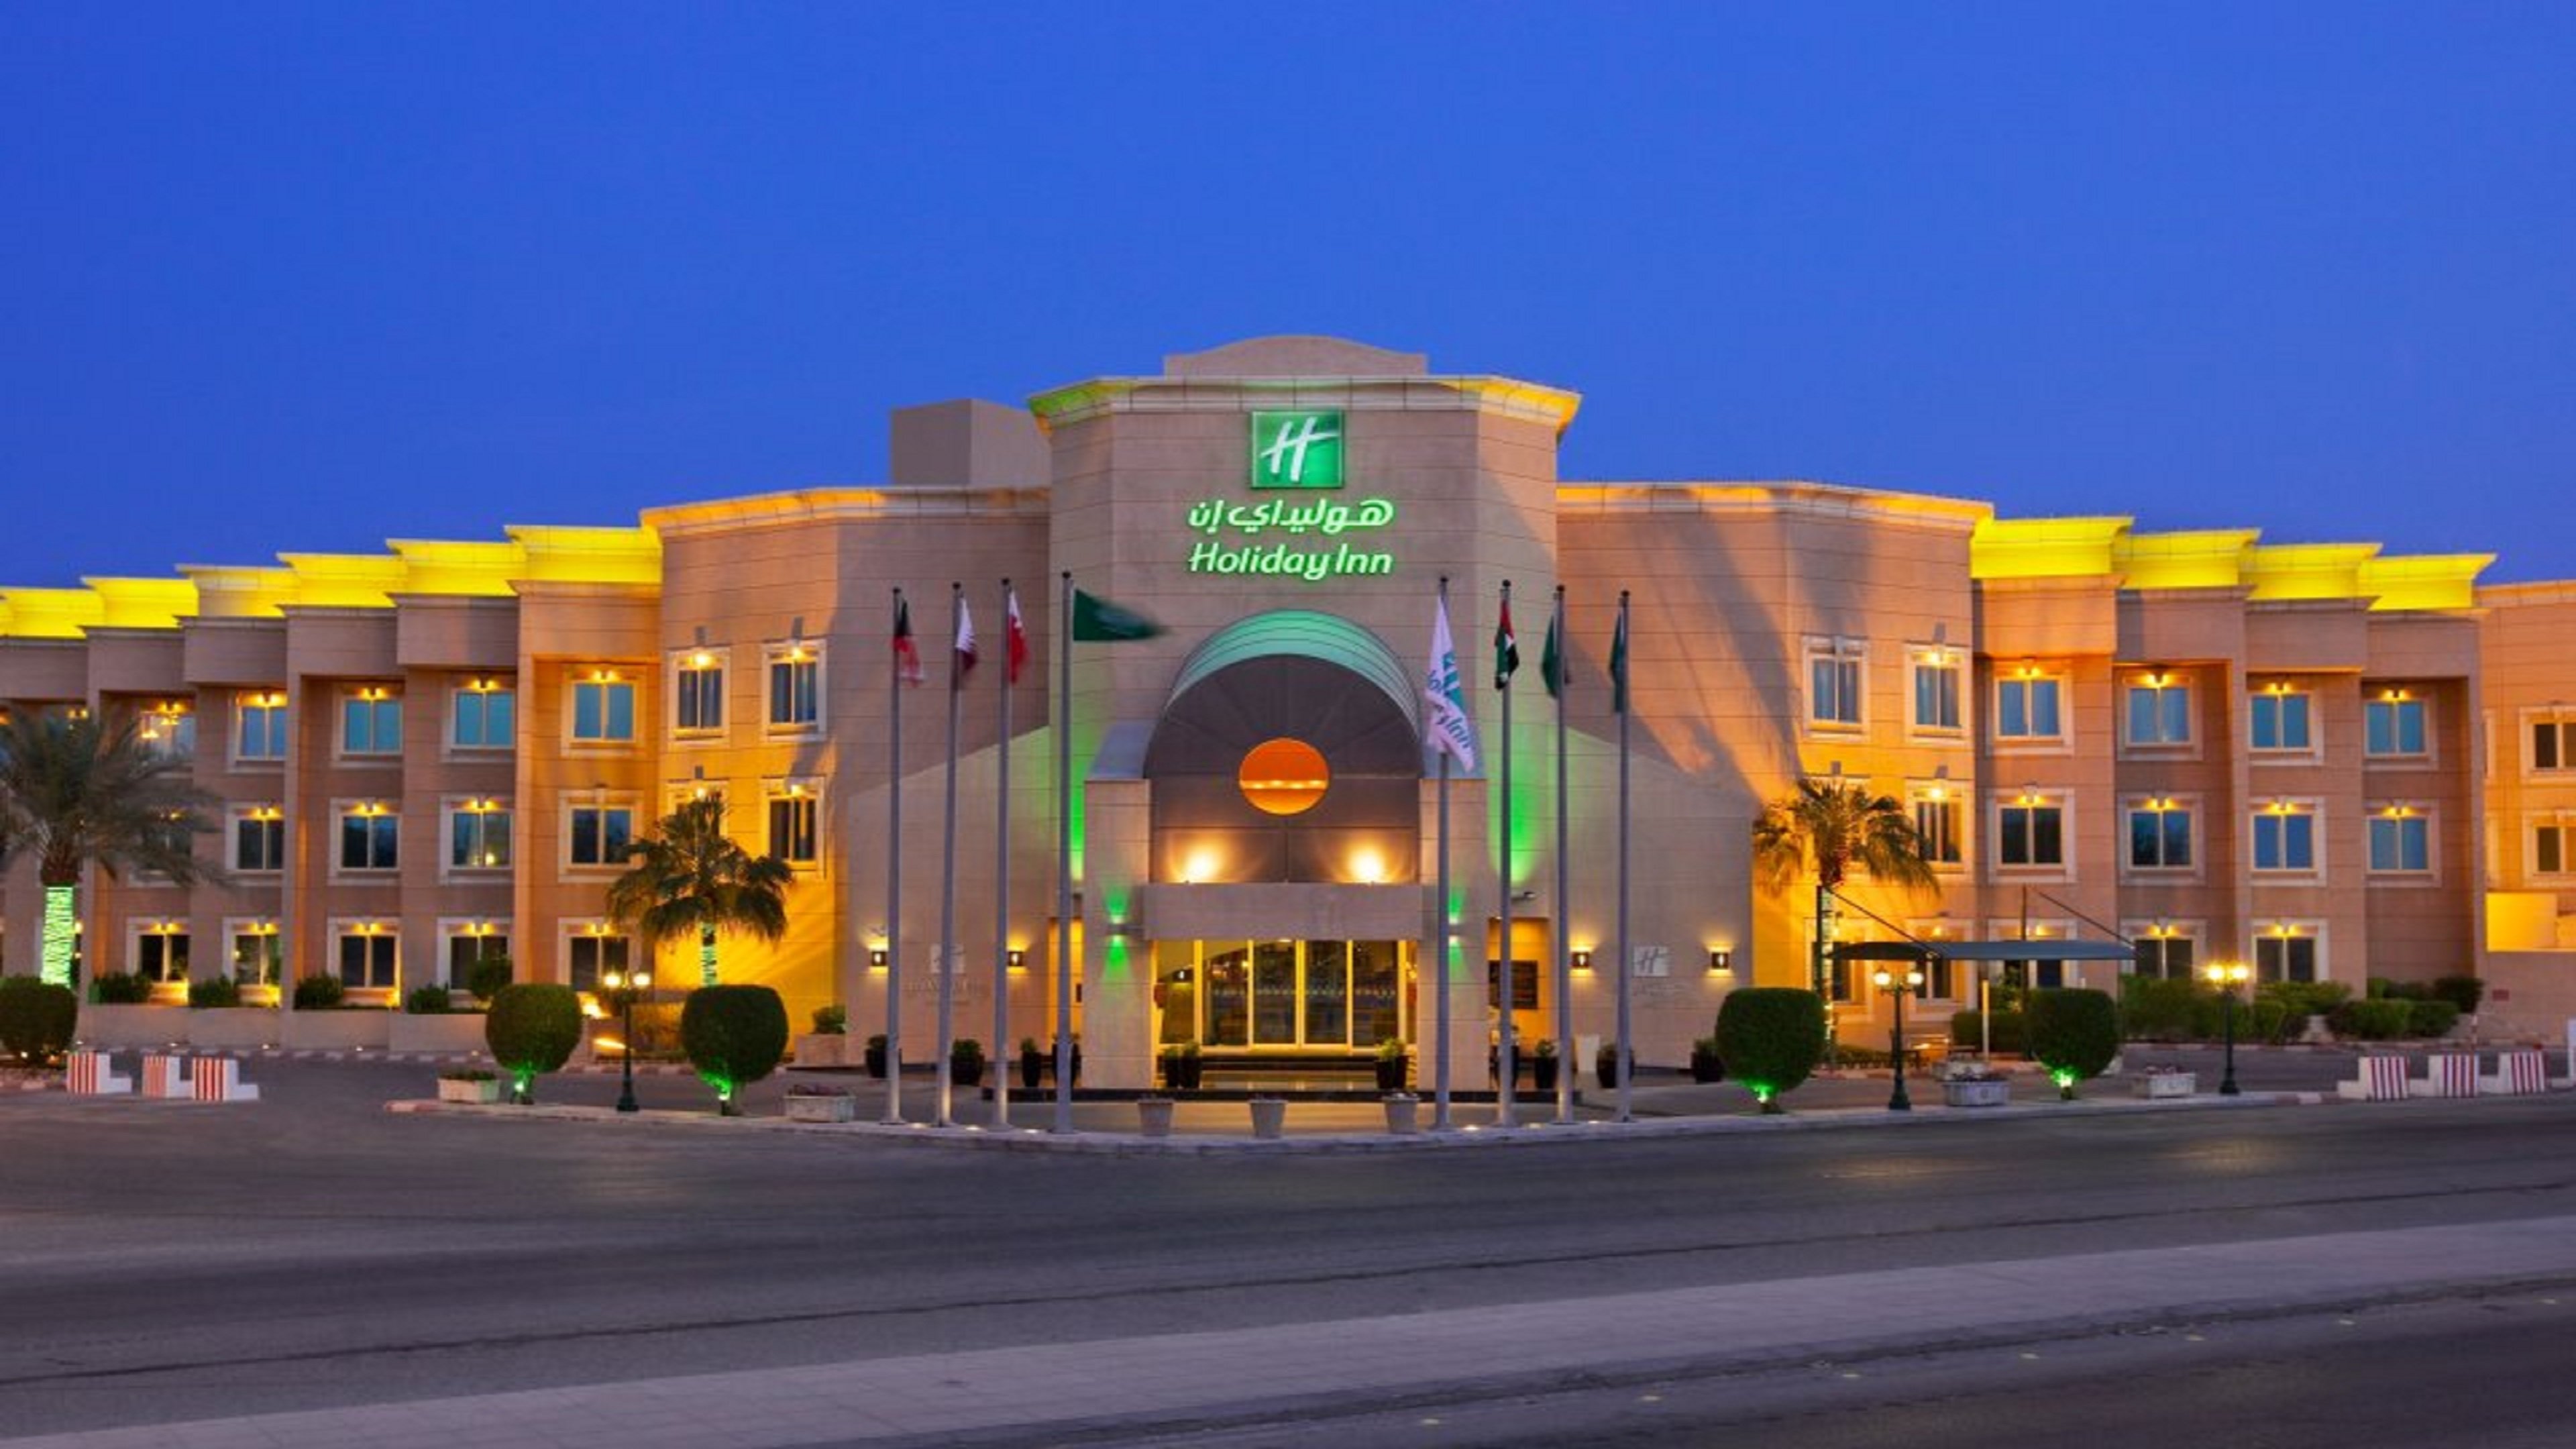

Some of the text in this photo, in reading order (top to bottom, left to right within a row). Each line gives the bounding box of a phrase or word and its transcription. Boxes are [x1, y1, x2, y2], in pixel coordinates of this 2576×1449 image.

[1188, 498, 1395, 535] هوليداي إن
[1188, 542, 1394, 581] Holiday Inn
